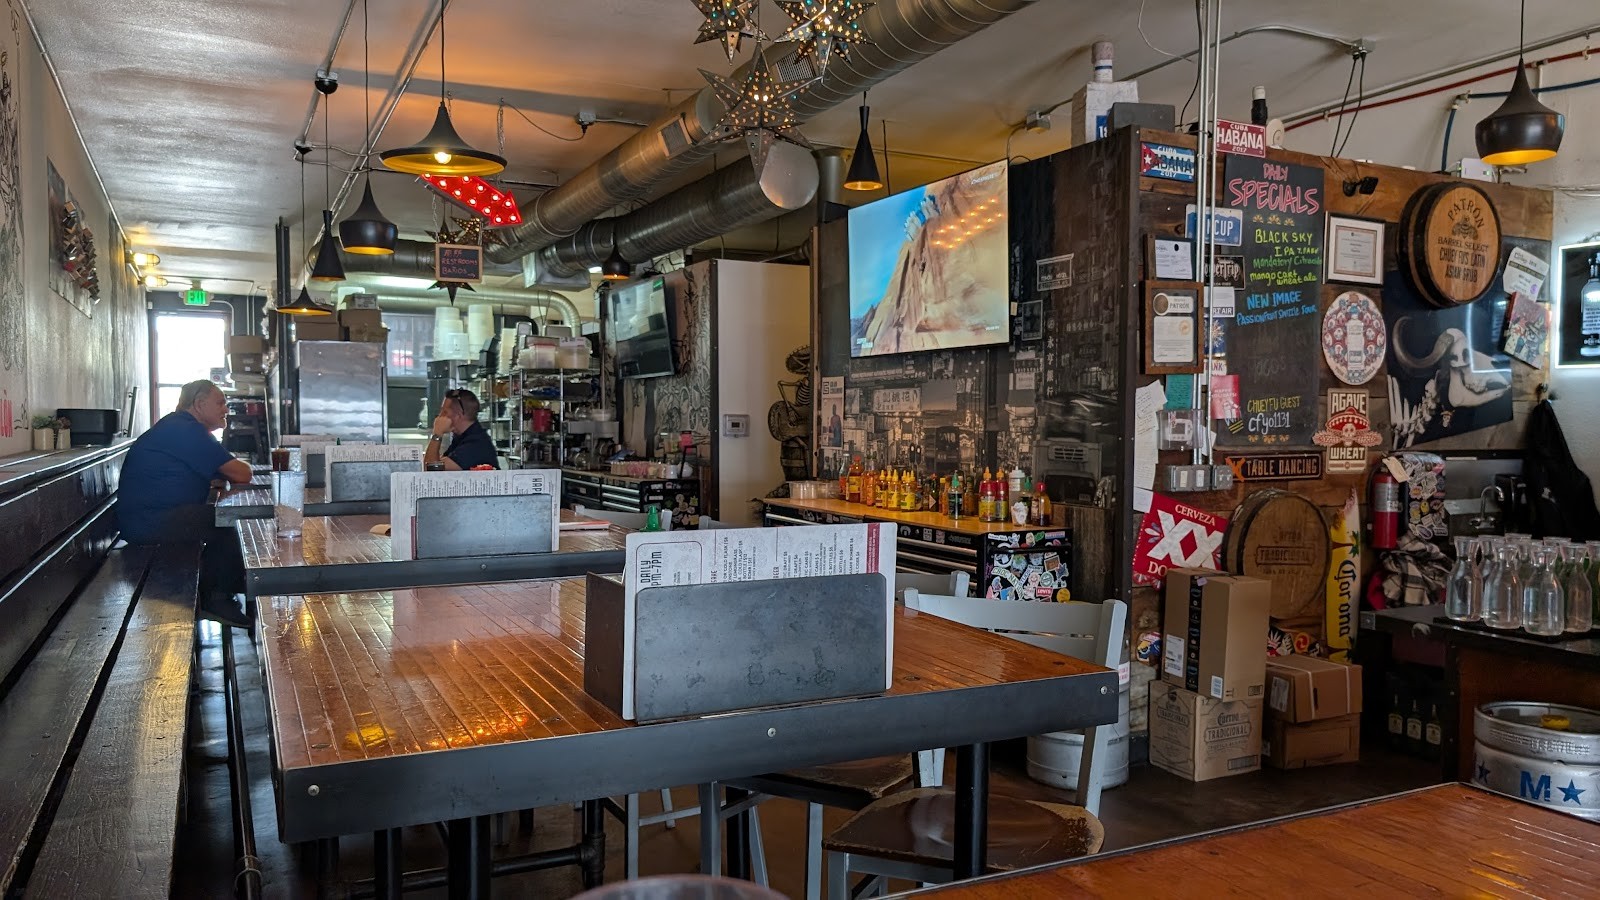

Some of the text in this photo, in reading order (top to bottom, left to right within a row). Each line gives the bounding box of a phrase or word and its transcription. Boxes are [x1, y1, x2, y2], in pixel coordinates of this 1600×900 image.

[1230, 123, 1248, 131] CUBA
[1216, 127, 1264, 150] HABANA
[1231, 145, 1247, 153] 2017
[1263, 163, 1288, 181] DAILY
[1229, 178, 1319, 215] SPECIALS
[1255, 228, 1313, 245] BLACK SKY
[1438, 237, 1489, 252] BARREL SELECT
[441, 257, 477, 266] RESTROOMS
[187, 291, 206, 304] EXIT
[1247, 290, 1303, 310] NEW IMAGE
[1280, 396, 1301, 409] GUEST
[1331, 393, 1366, 414] AGAVE
[1330, 447, 1365, 459] WHEAT
[1246, 460, 1275, 476] TABLE
[1279, 458, 1317, 475] DANCING
[532, 478, 542, 495] HAP
[1174, 504, 1216, 526] CERVEZA
[1147, 509, 1224, 570] XX
[640, 560, 651, 583] DAILY
[1334, 560, 1357, 638] Corona
[1207, 725, 1248, 740] TRADICIONAL
[1520, 770, 1551, 802] M
